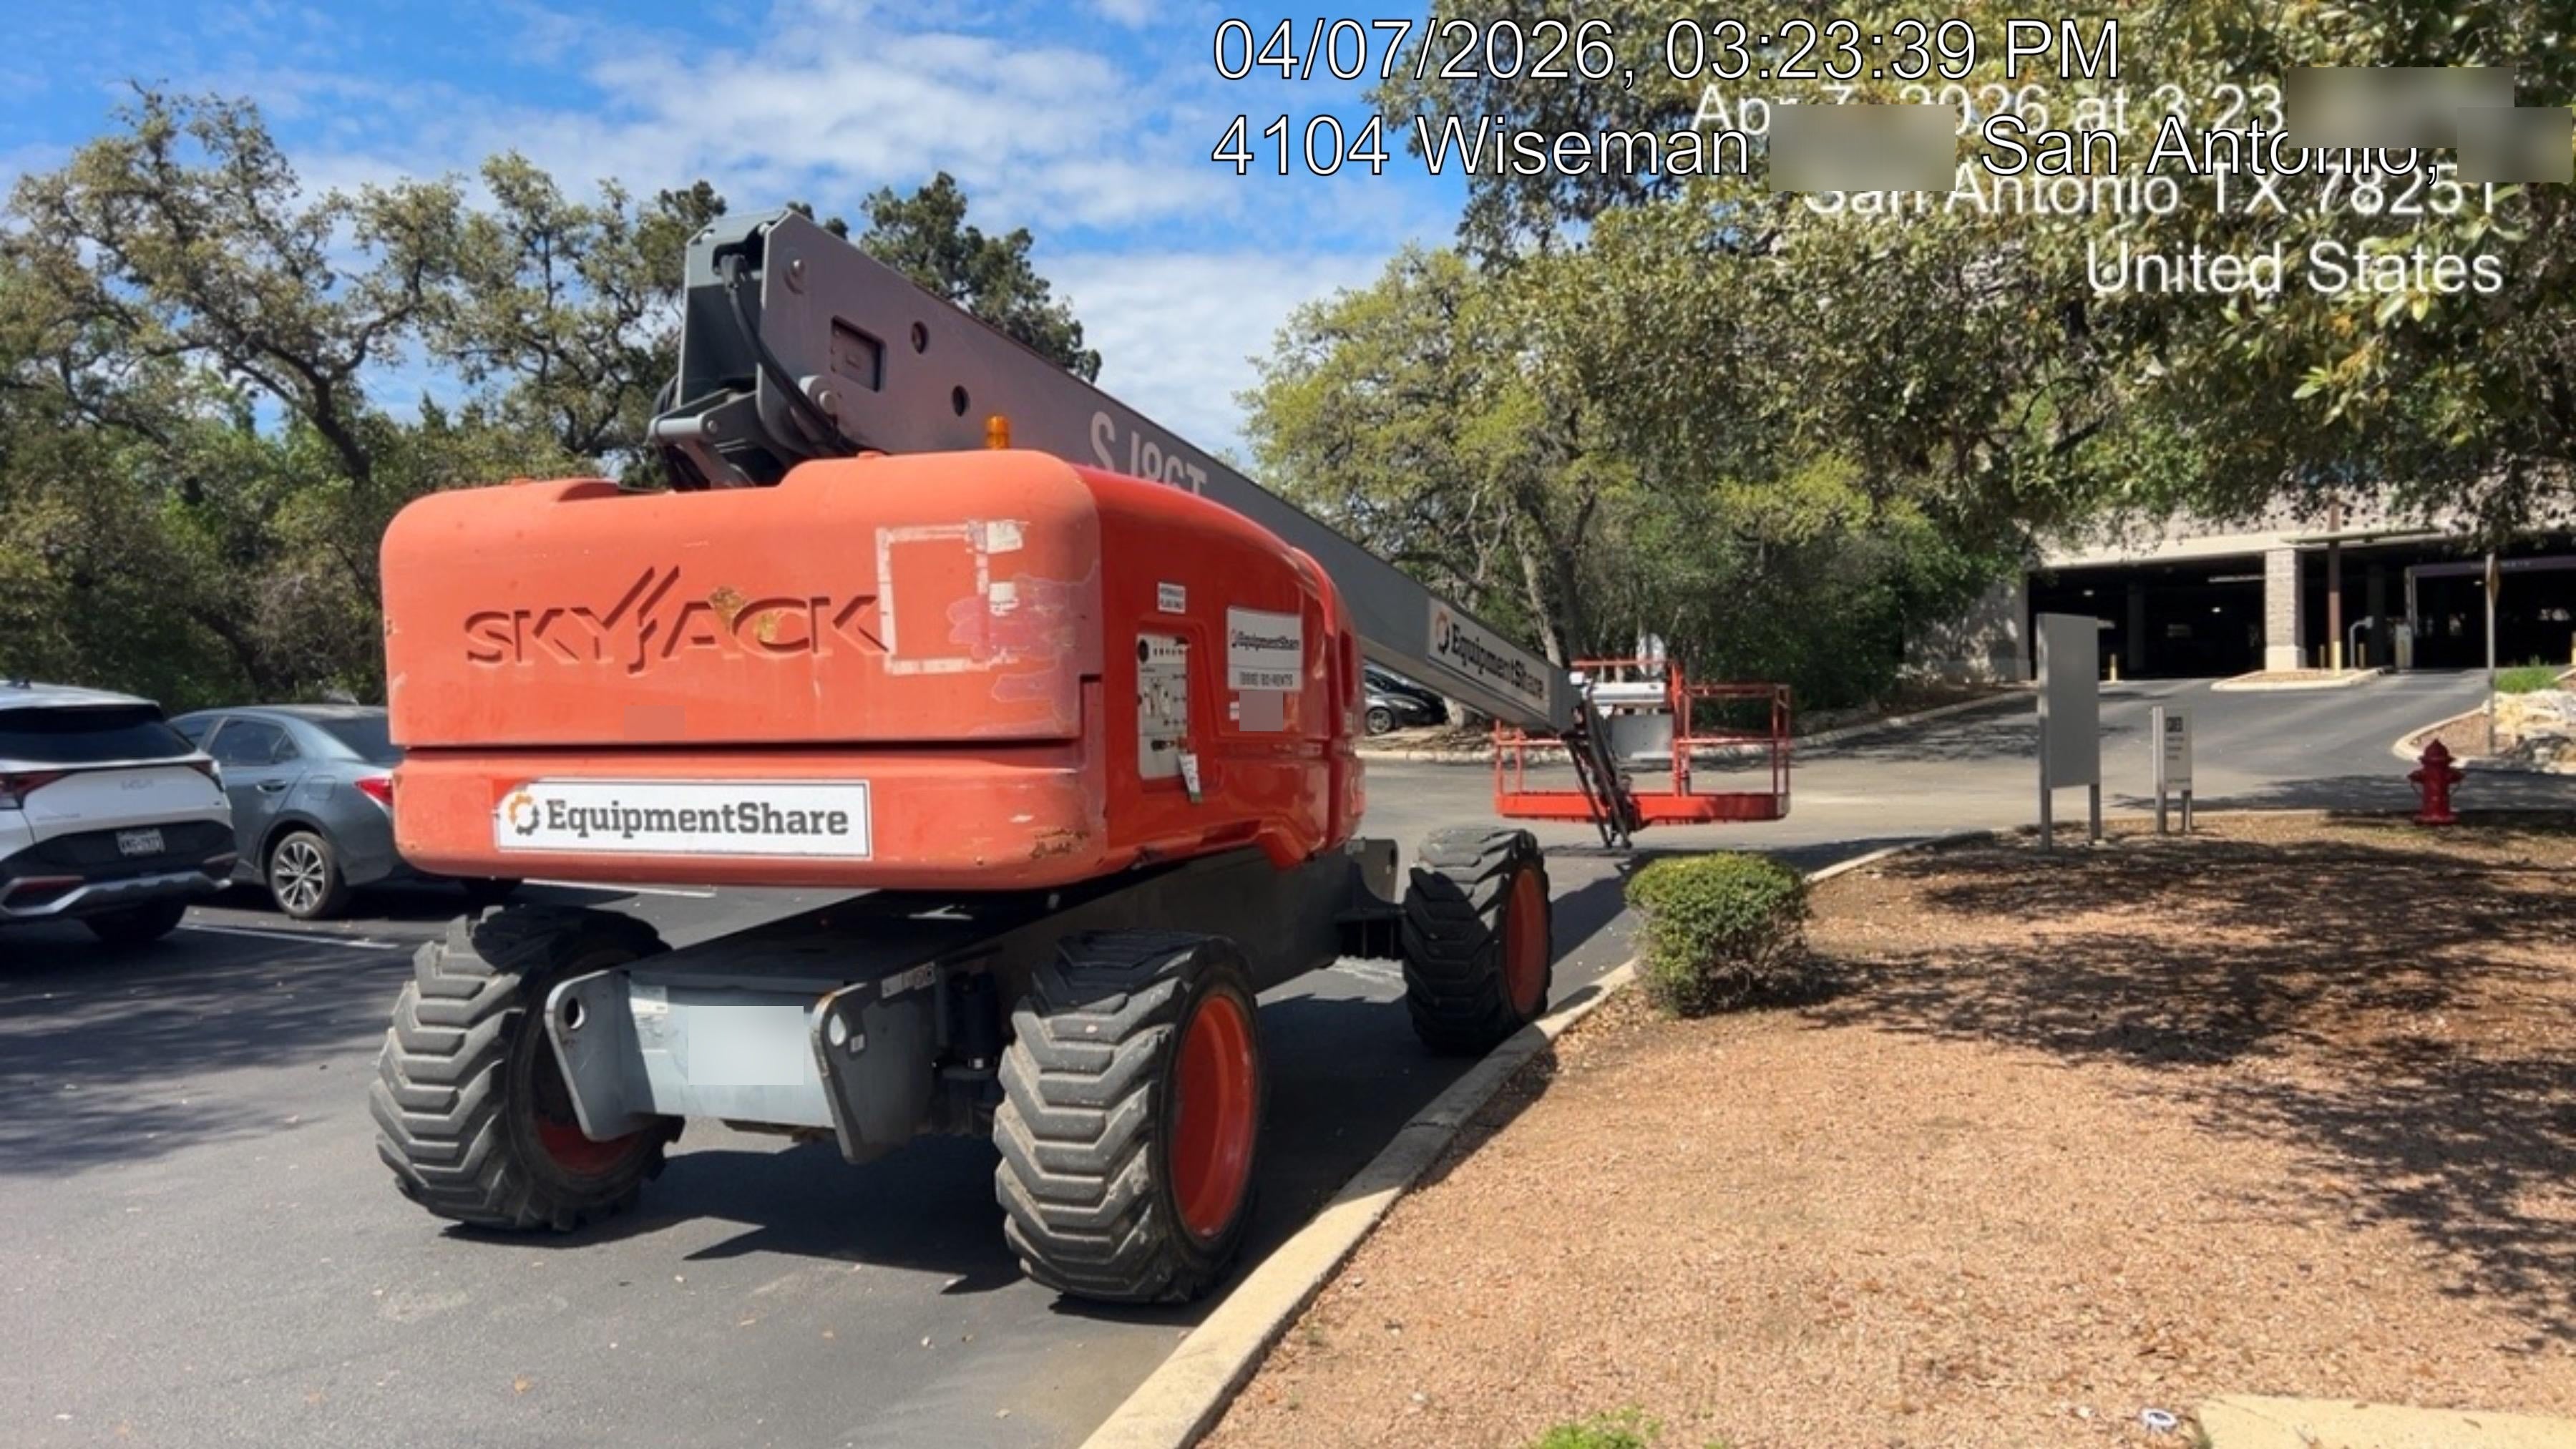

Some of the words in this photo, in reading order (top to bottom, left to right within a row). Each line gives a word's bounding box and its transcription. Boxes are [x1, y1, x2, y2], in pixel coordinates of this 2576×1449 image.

[464, 565, 890, 674] SKYJACK
[1452, 623, 1544, 700] EquipmentShare
[546, 798, 849, 838] EquipmentShare
